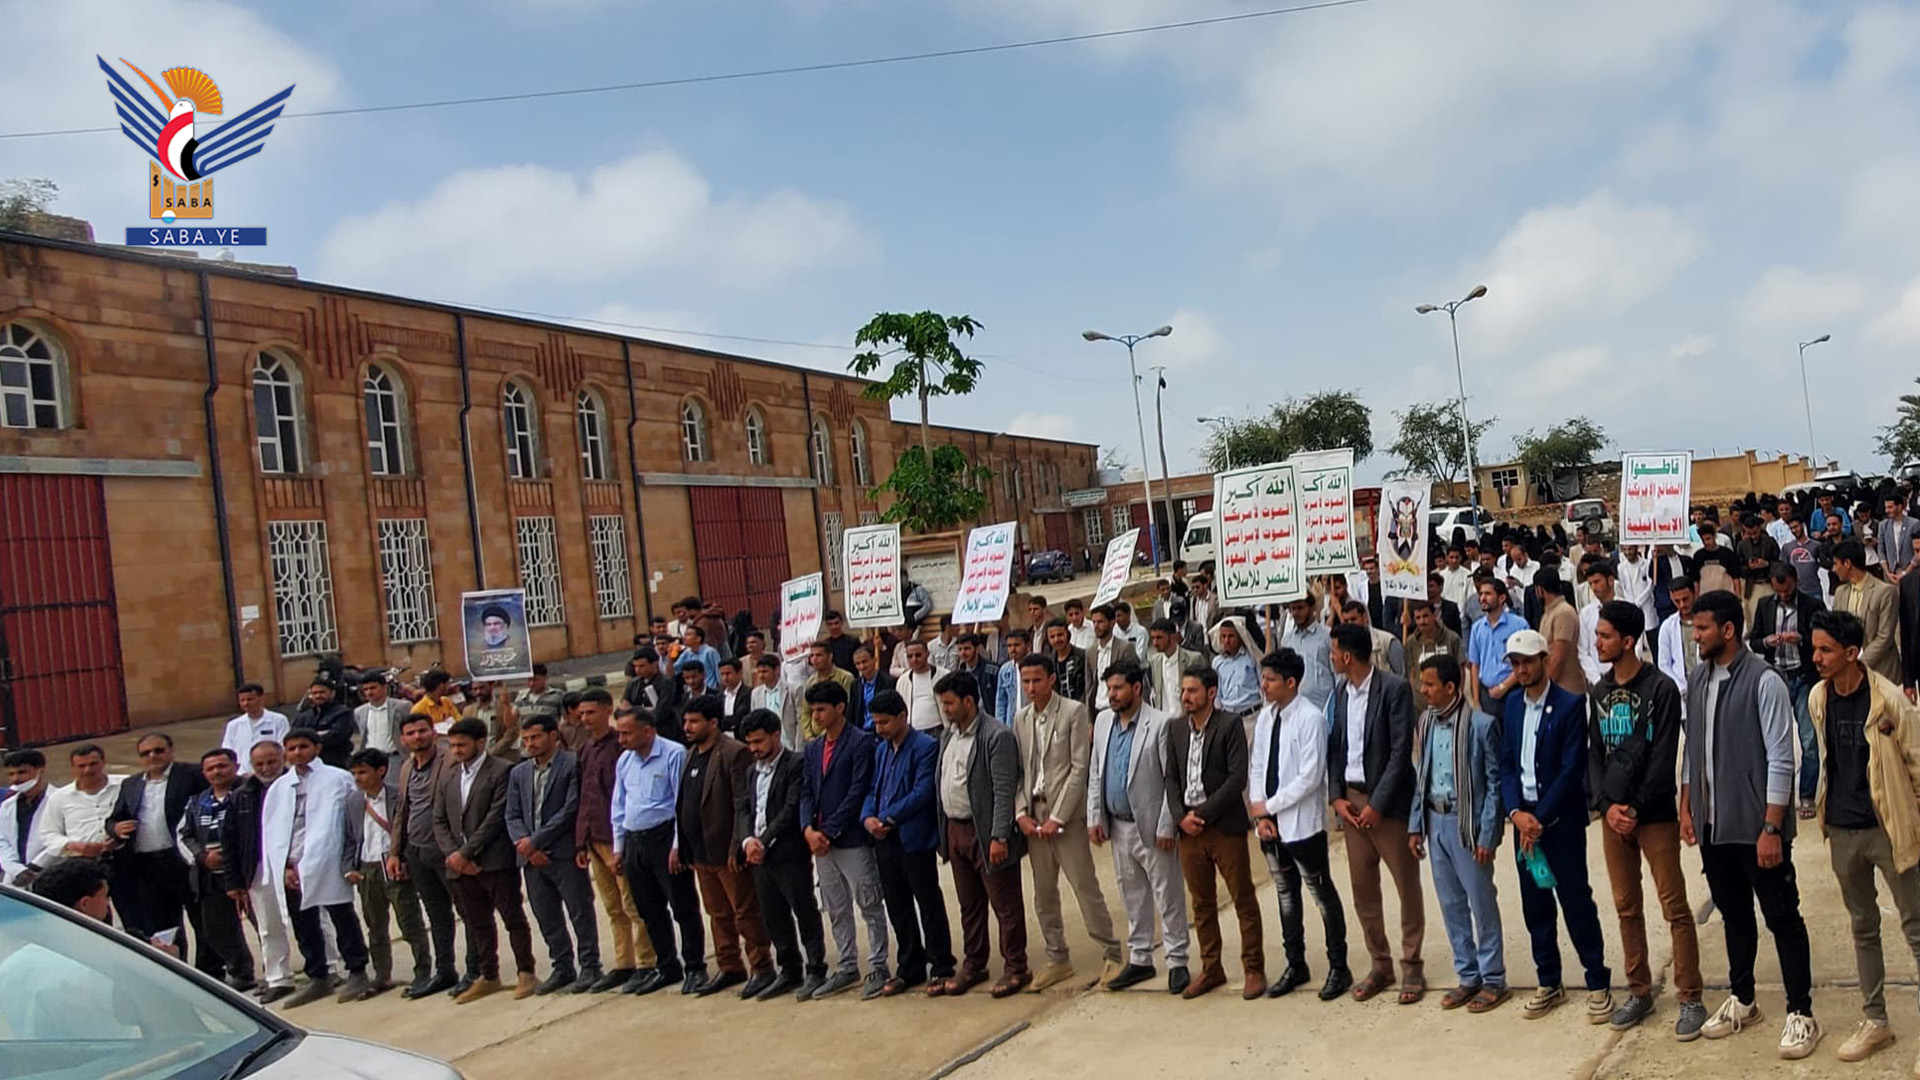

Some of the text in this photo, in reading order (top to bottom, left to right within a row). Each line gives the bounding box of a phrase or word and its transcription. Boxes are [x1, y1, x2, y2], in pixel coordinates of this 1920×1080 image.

[1631, 458, 1680, 480] قاطعوا
[1224, 475, 1292, 506] الله أكبر
[1327, 474, 1346, 489] الله
[1224, 503, 1293, 523] الموت لأمريكا
[851, 534, 895, 555] الله أكبر
[1225, 524, 1295, 547] الموت لإسرائيل
[1226, 545, 1295, 568] اللعنة على اليهود
[1227, 564, 1295, 594] النصر للإسلام
